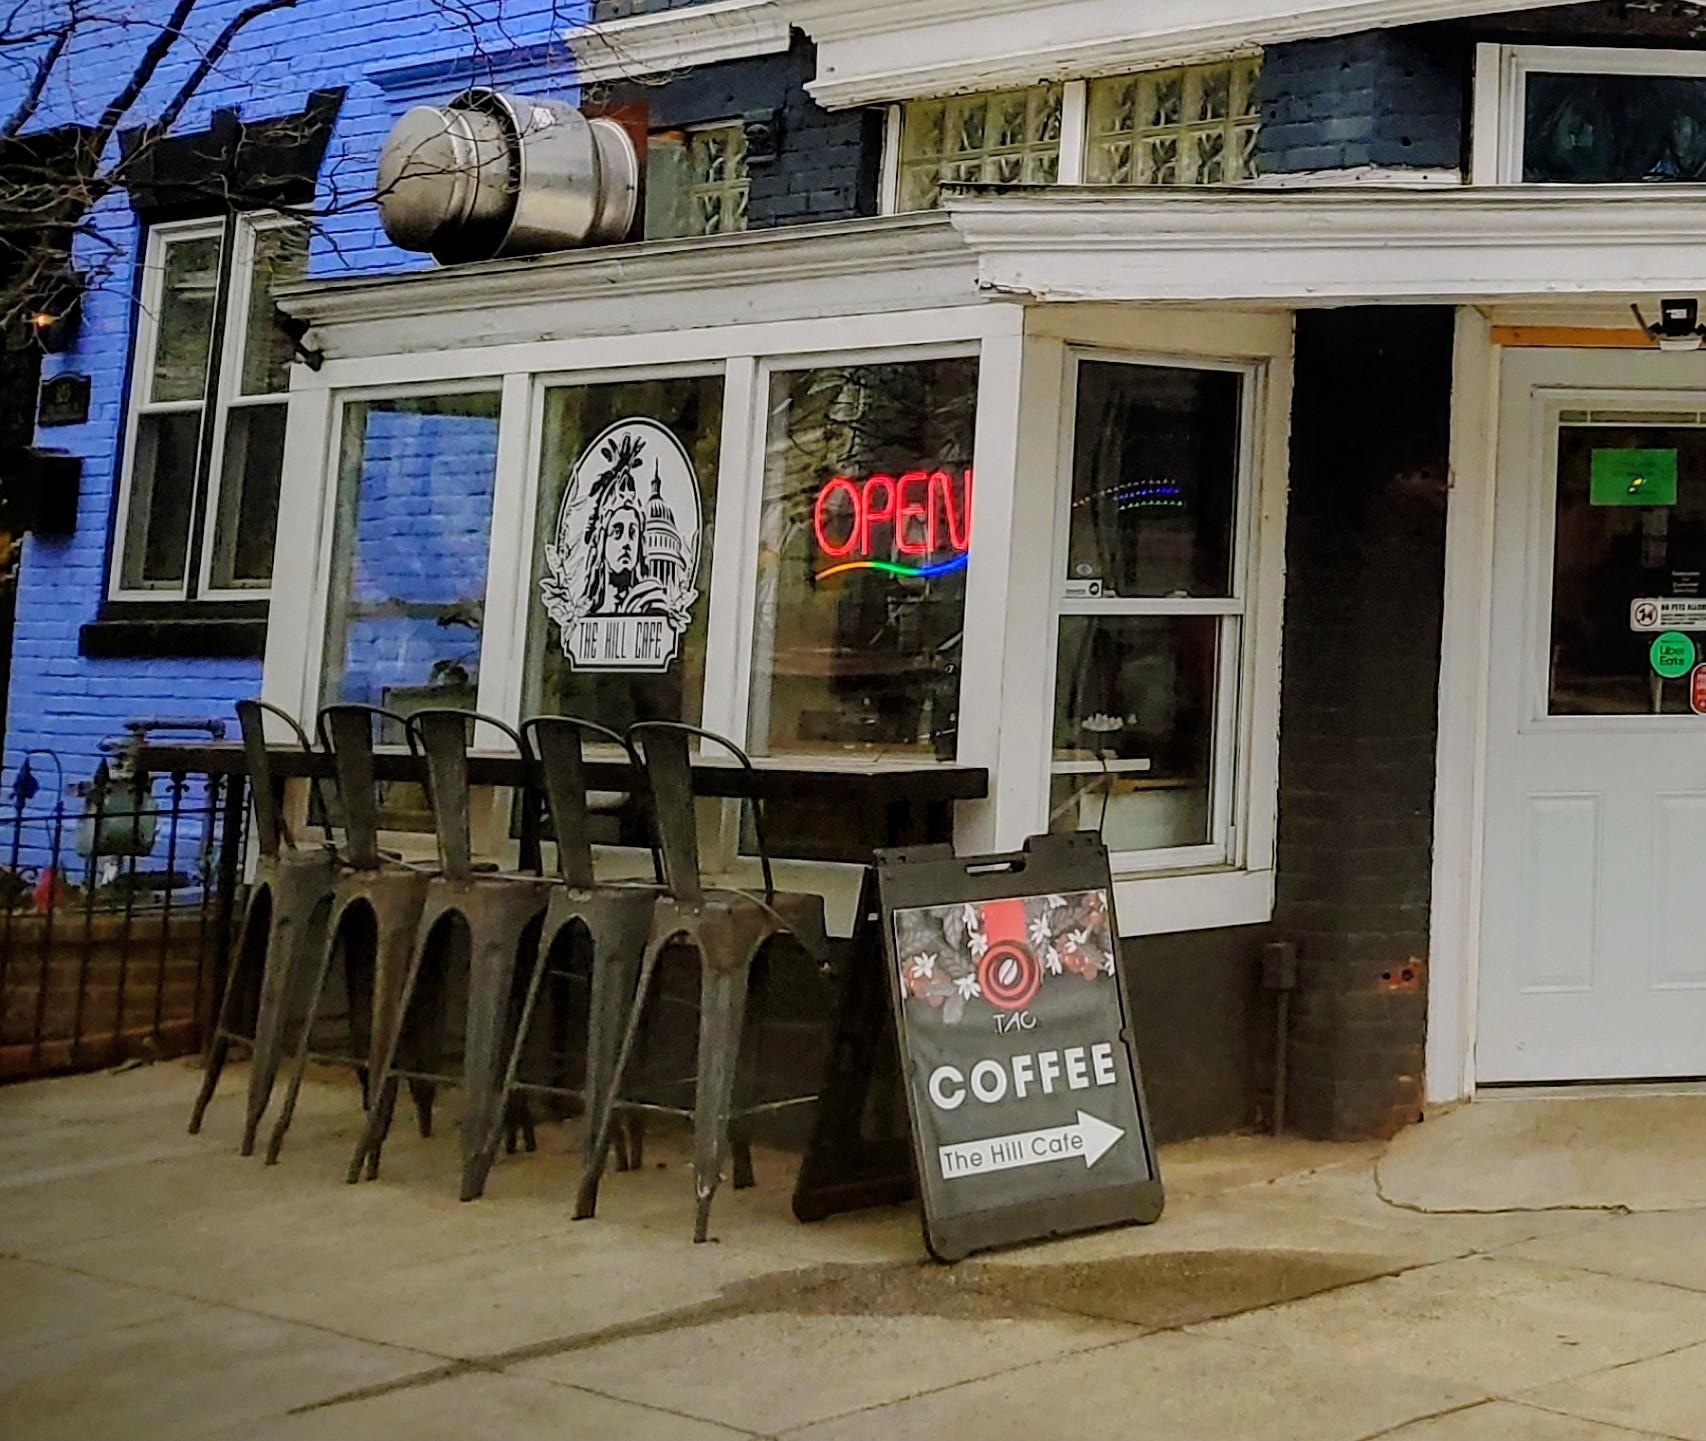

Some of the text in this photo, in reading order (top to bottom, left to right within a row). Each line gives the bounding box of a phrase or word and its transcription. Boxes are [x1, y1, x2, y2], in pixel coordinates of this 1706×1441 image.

[814, 468, 971, 556] OPEN
[579, 621, 663, 659] THE HILL CAFE
[1660, 646, 1685, 655] Uber
[1660, 656, 1685, 666] Eats
[992, 1010, 1038, 1035] TAC
[928, 1042, 1117, 1110] COFFEE
[944, 1132, 1084, 1171] The Hill Cafe
